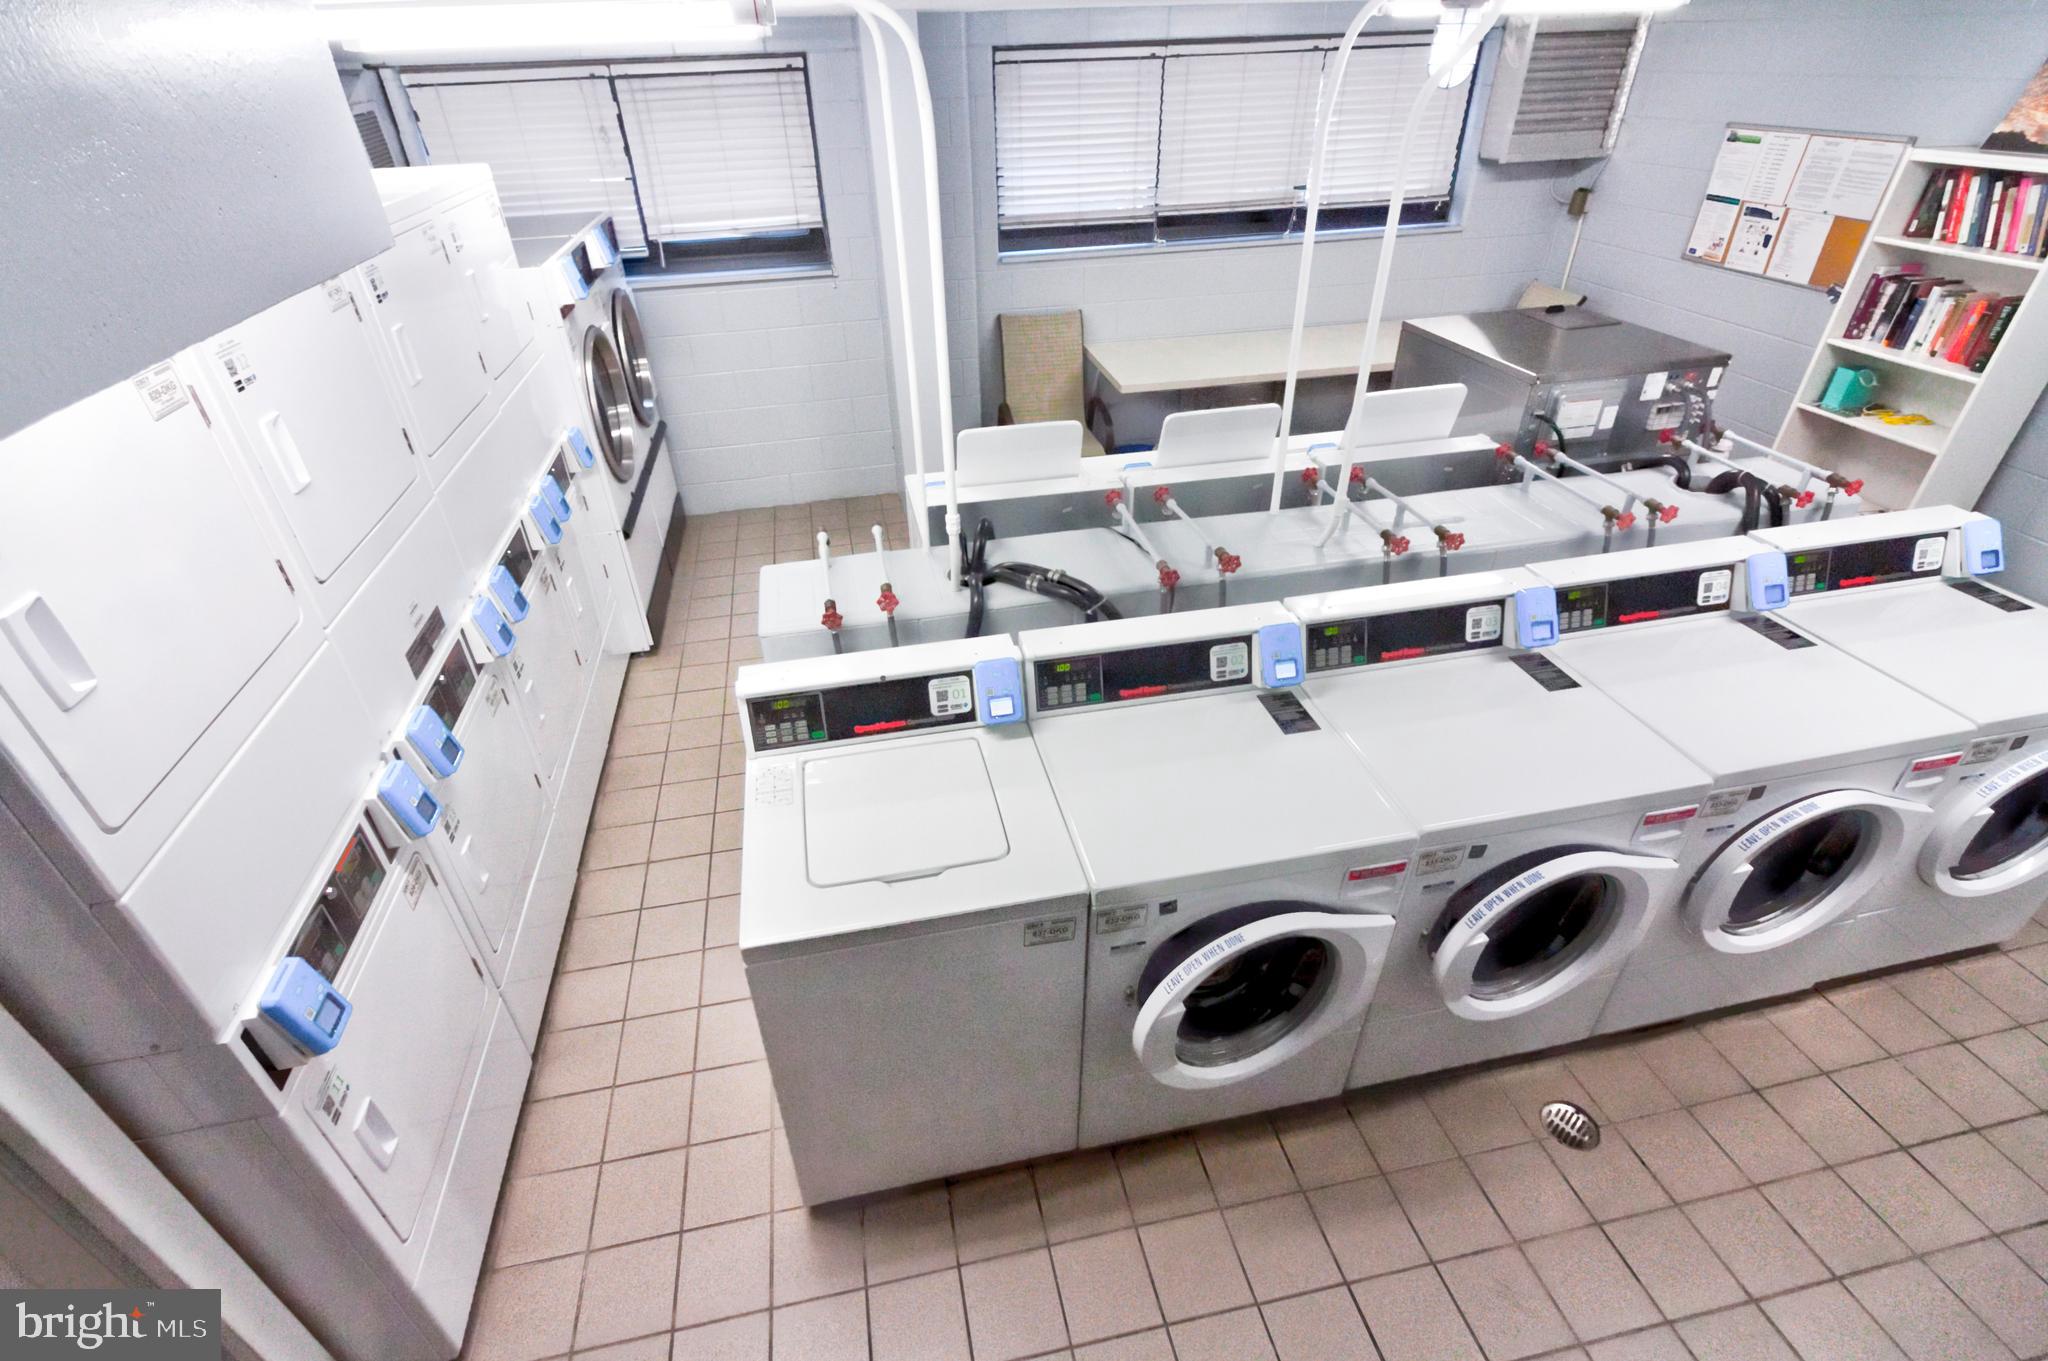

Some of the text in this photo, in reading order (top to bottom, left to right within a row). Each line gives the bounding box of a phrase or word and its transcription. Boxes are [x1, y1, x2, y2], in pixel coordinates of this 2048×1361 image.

[952, 688, 967, 699] 01
[1738, 832, 1762, 852] LEAVE
[1758, 819, 1781, 837] OPEN
[1464, 869, 1545, 930] LEAVE OPEN WHEN DONE
[1163, 932, 1246, 995] LEAVE OPEN WHEN DONE
